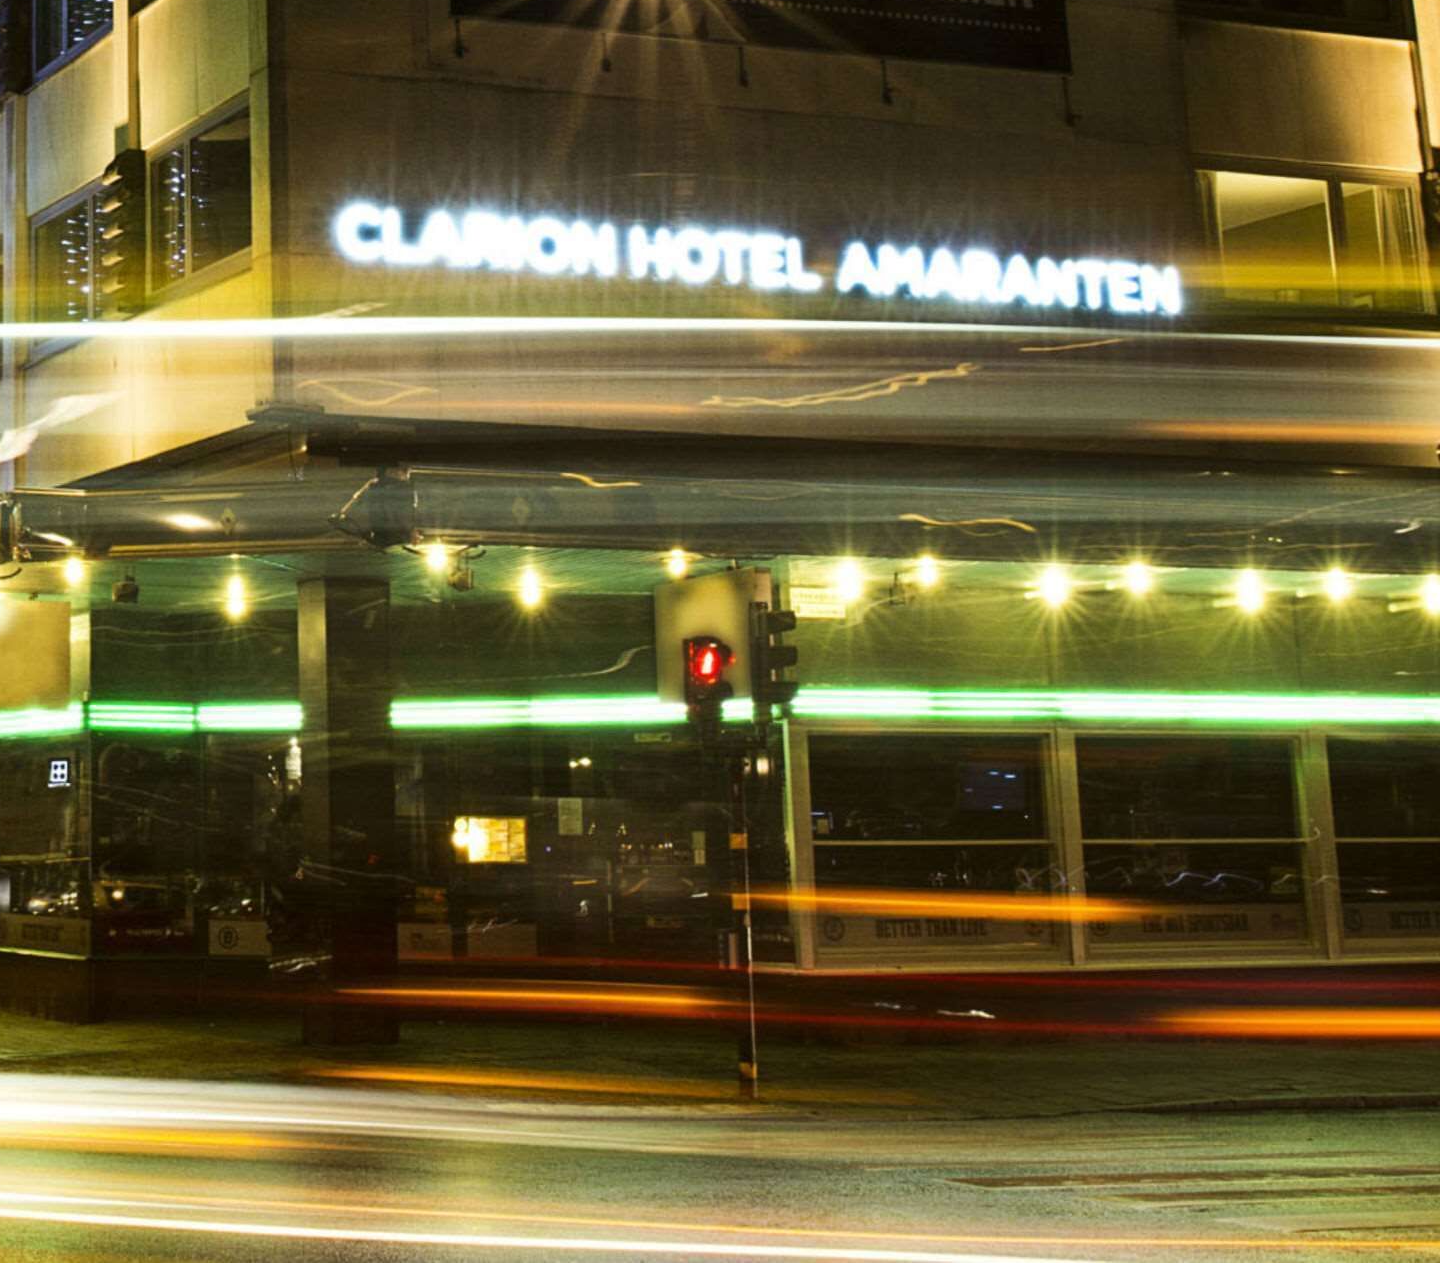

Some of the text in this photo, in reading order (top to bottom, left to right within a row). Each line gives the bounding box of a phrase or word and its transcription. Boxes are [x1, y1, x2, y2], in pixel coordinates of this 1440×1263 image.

[334, 201, 1182, 315] CLARION HOTEL AMARANTEN
